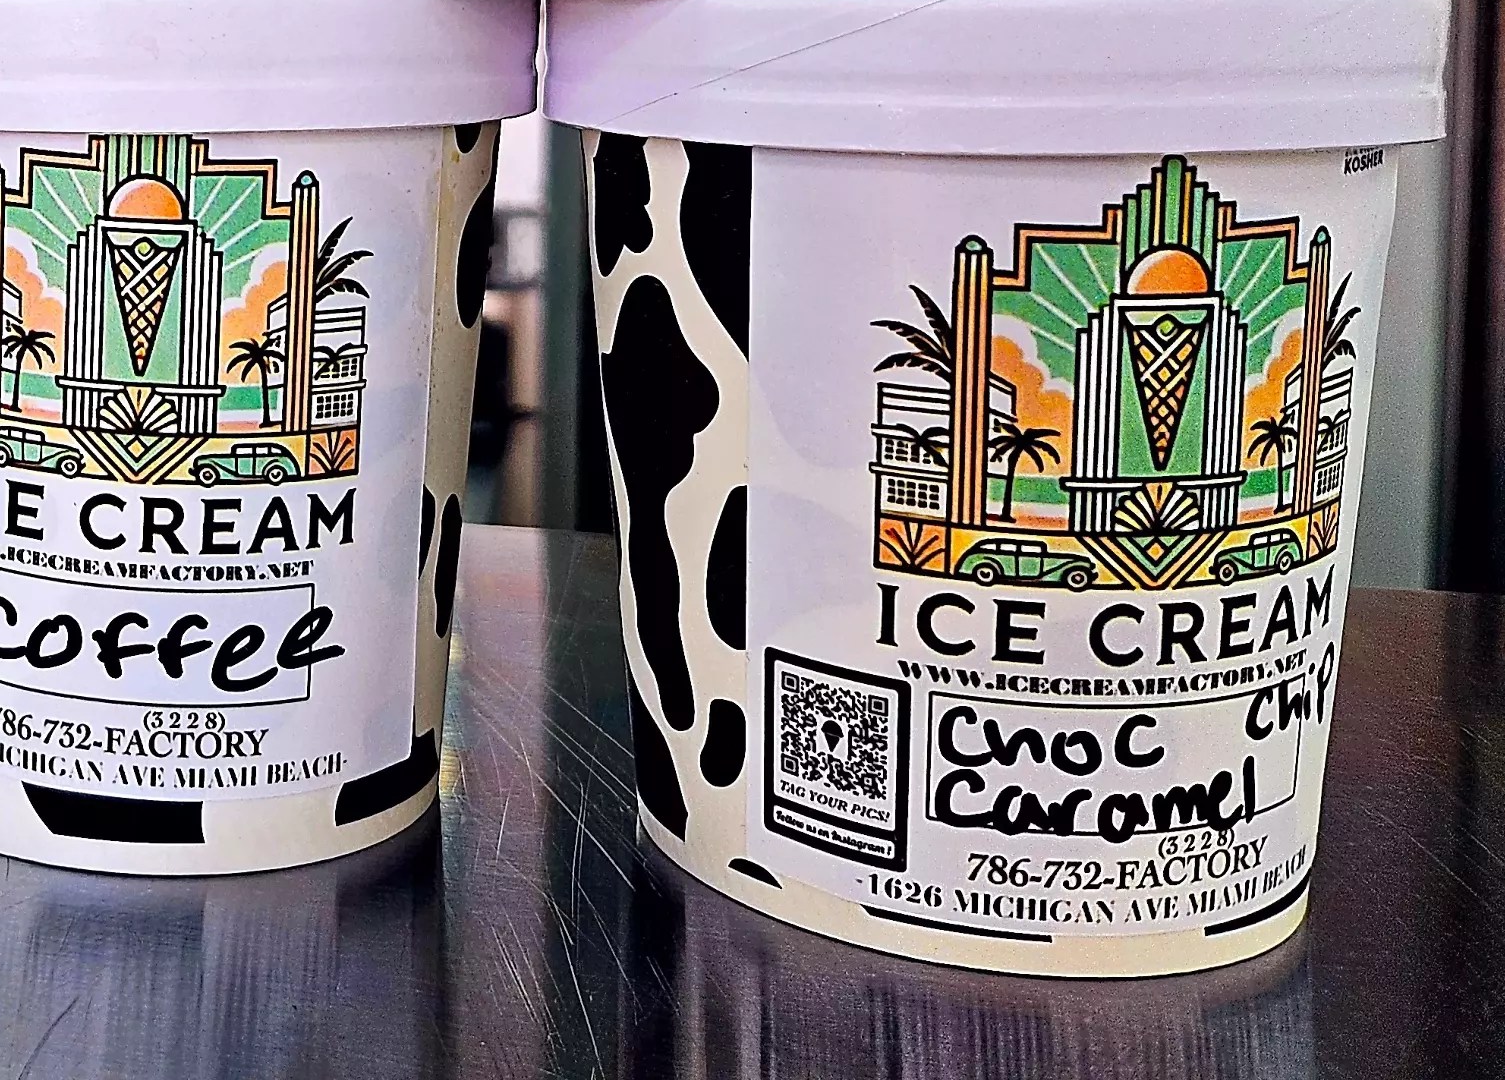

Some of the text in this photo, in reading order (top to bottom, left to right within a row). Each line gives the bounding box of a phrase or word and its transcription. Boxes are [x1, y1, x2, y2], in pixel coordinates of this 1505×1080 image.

[1343, 149, 1384, 175] KOSHER
[79, 488, 357, 555] CREAM
[876, 563, 1335, 668] ICE CREAM
[897, 648, 1308, 697] WWW.ICECREAMFACTORY.NET
[112, 764, 165, 788] AVE
[173, 765, 257, 789] MIAMI
[780, 780, 890, 823] TAG YOUR PICS!
[967, 835, 1269, 891] 786-732-FACTORY
[952, 889, 1115, 925] MICHIGAN
[1124, 895, 1179, 923] AVE
[1186, 876, 1258, 917] MIAMI
